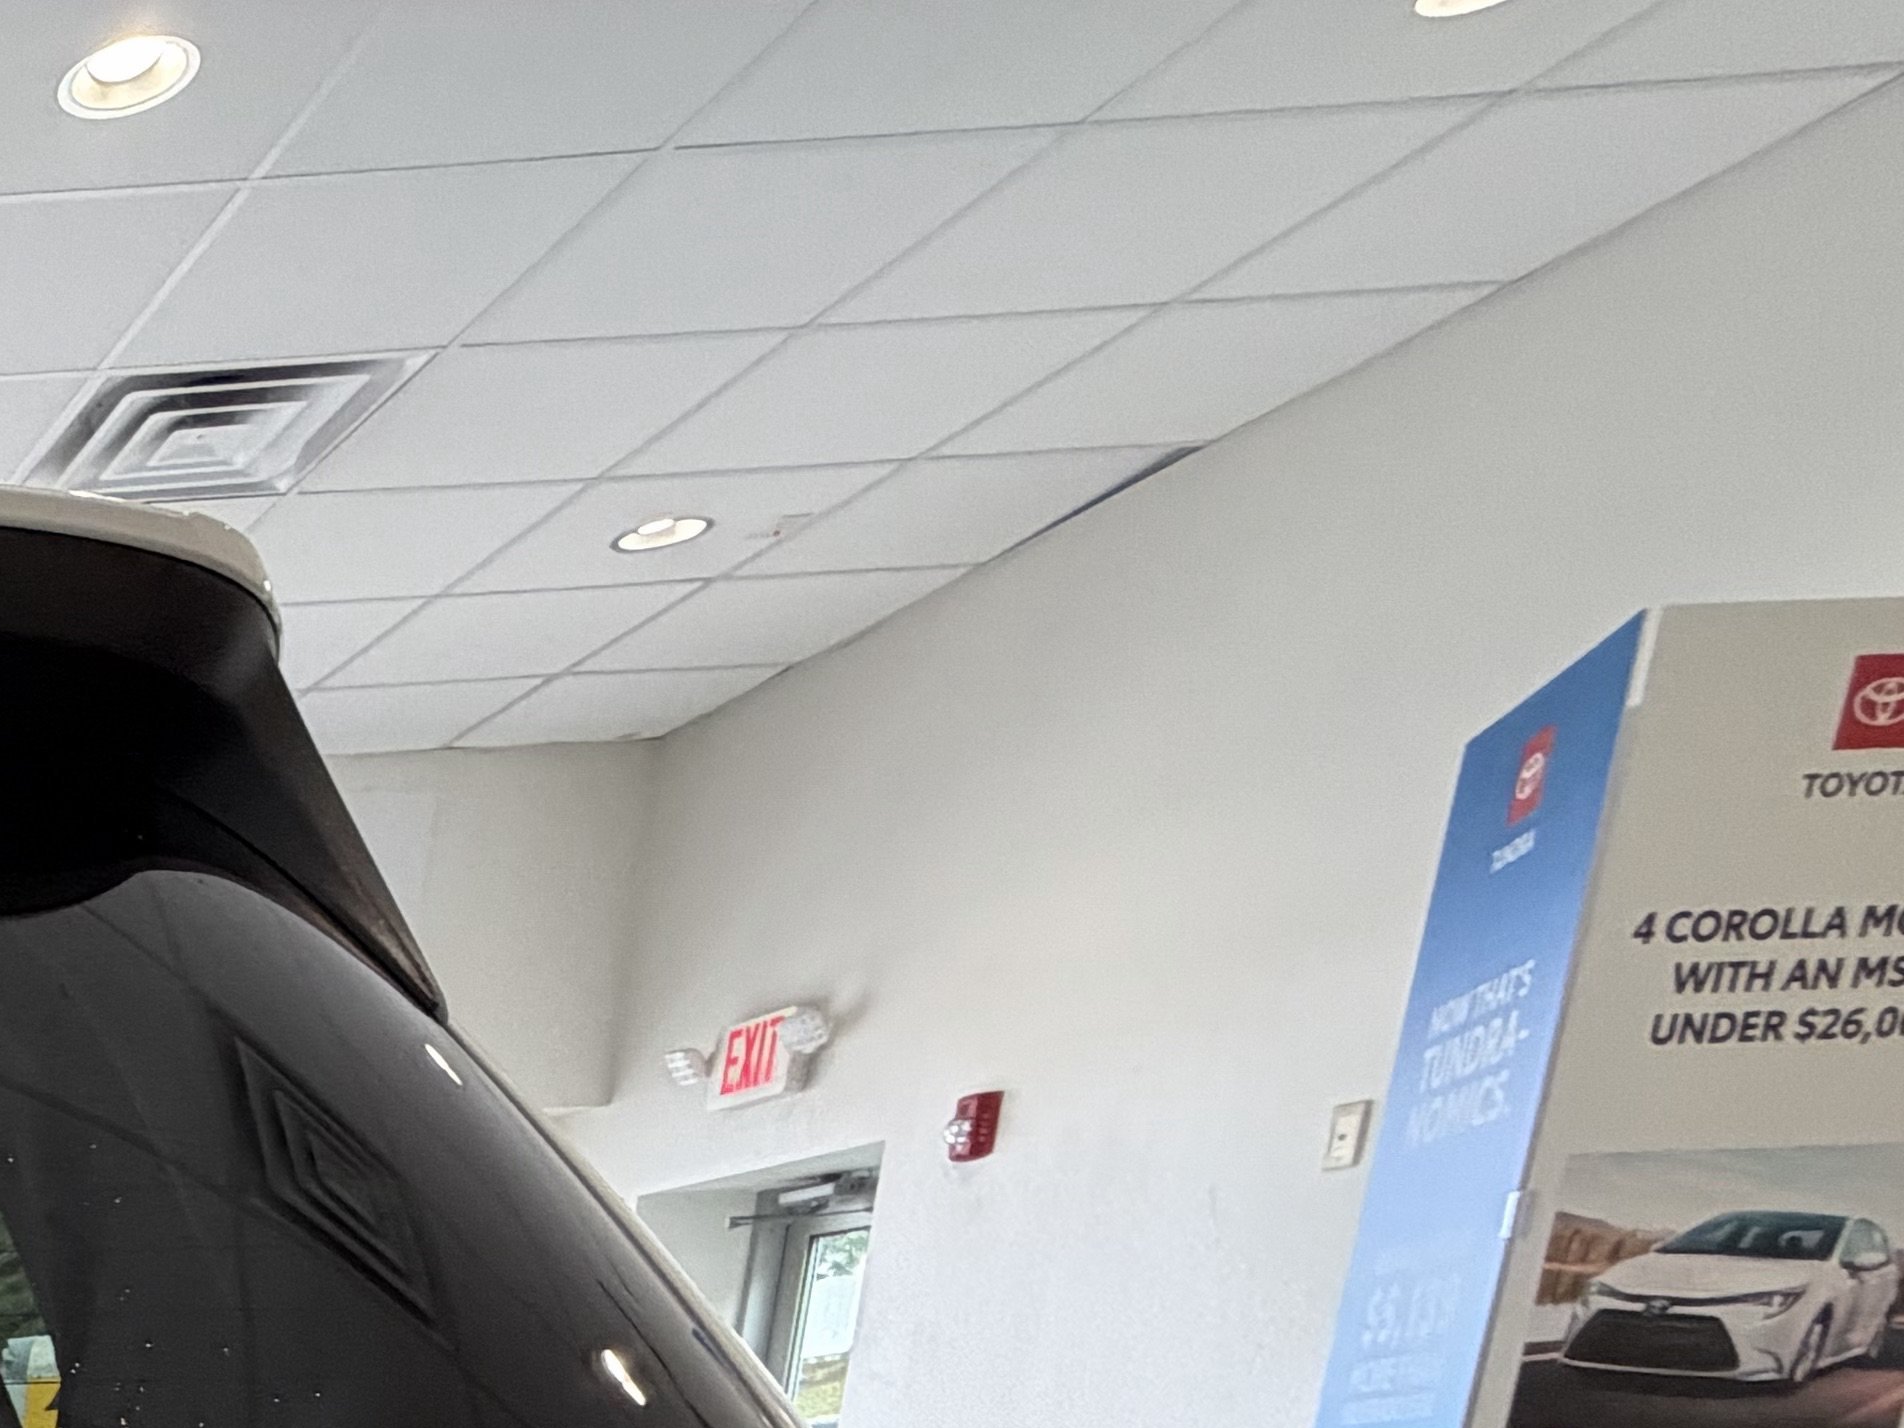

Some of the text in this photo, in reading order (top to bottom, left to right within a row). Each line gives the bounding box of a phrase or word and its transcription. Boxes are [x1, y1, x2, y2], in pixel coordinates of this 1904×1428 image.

[1802, 770, 1904, 799] TOYOT
[1632, 903, 1904, 944] 4 COROLLA M
[1674, 959, 1777, 994] WITH
[1780, 957, 1845, 991] AN
[1650, 1004, 1904, 1046] UNDER $26,0
[720, 1015, 786, 1096] EXIT
